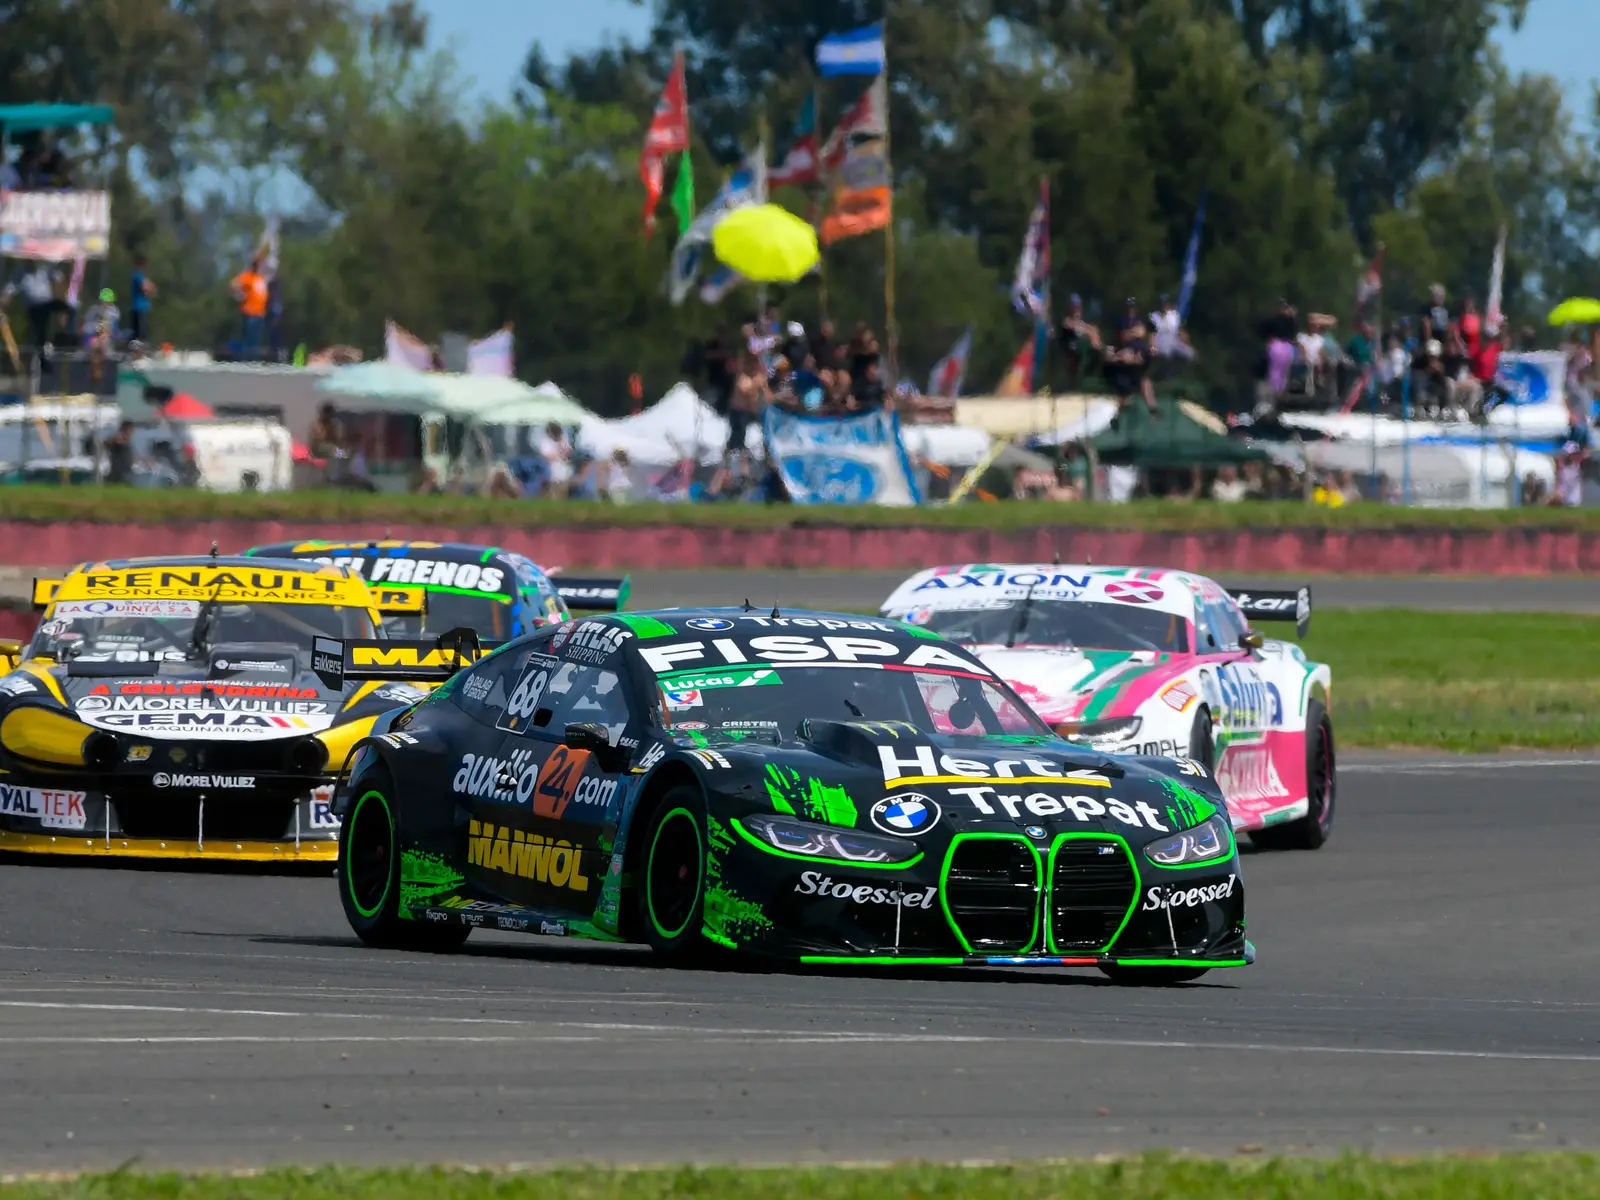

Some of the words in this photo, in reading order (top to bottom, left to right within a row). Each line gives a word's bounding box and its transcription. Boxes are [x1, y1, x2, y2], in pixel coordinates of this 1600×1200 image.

[86, 572, 347, 591] RENAULT
[370, 557, 504, 593] FRENOS
[911, 573, 1092, 592] AXION
[87, 588, 346, 600] CONCESIONARIOS
[1004, 589, 1084, 598] energy
[84, 602, 161, 615] QUINTA
[739, 616, 894, 632] Trepat
[568, 621, 634, 654] ATLAS
[565, 645, 609, 665] SHIPPING
[637, 635, 994, 676] FISPA
[664, 676, 735, 691] Lucas
[508, 669, 548, 718] 68
[114, 696, 215, 711] MOREL
[217, 698, 327, 715] VULLIEZ
[94, 713, 271, 727] GEMA
[140, 726, 264, 734] MAQUINARIAS
[877, 745, 1112, 780] Hertz
[171, 774, 211, 787] MOREL
[947, 786, 1170, 832] Trepat
[43, 817, 83, 826] ITALY
[467, 819, 589, 892] MANNOL
[794, 870, 938, 910] Stoessel
